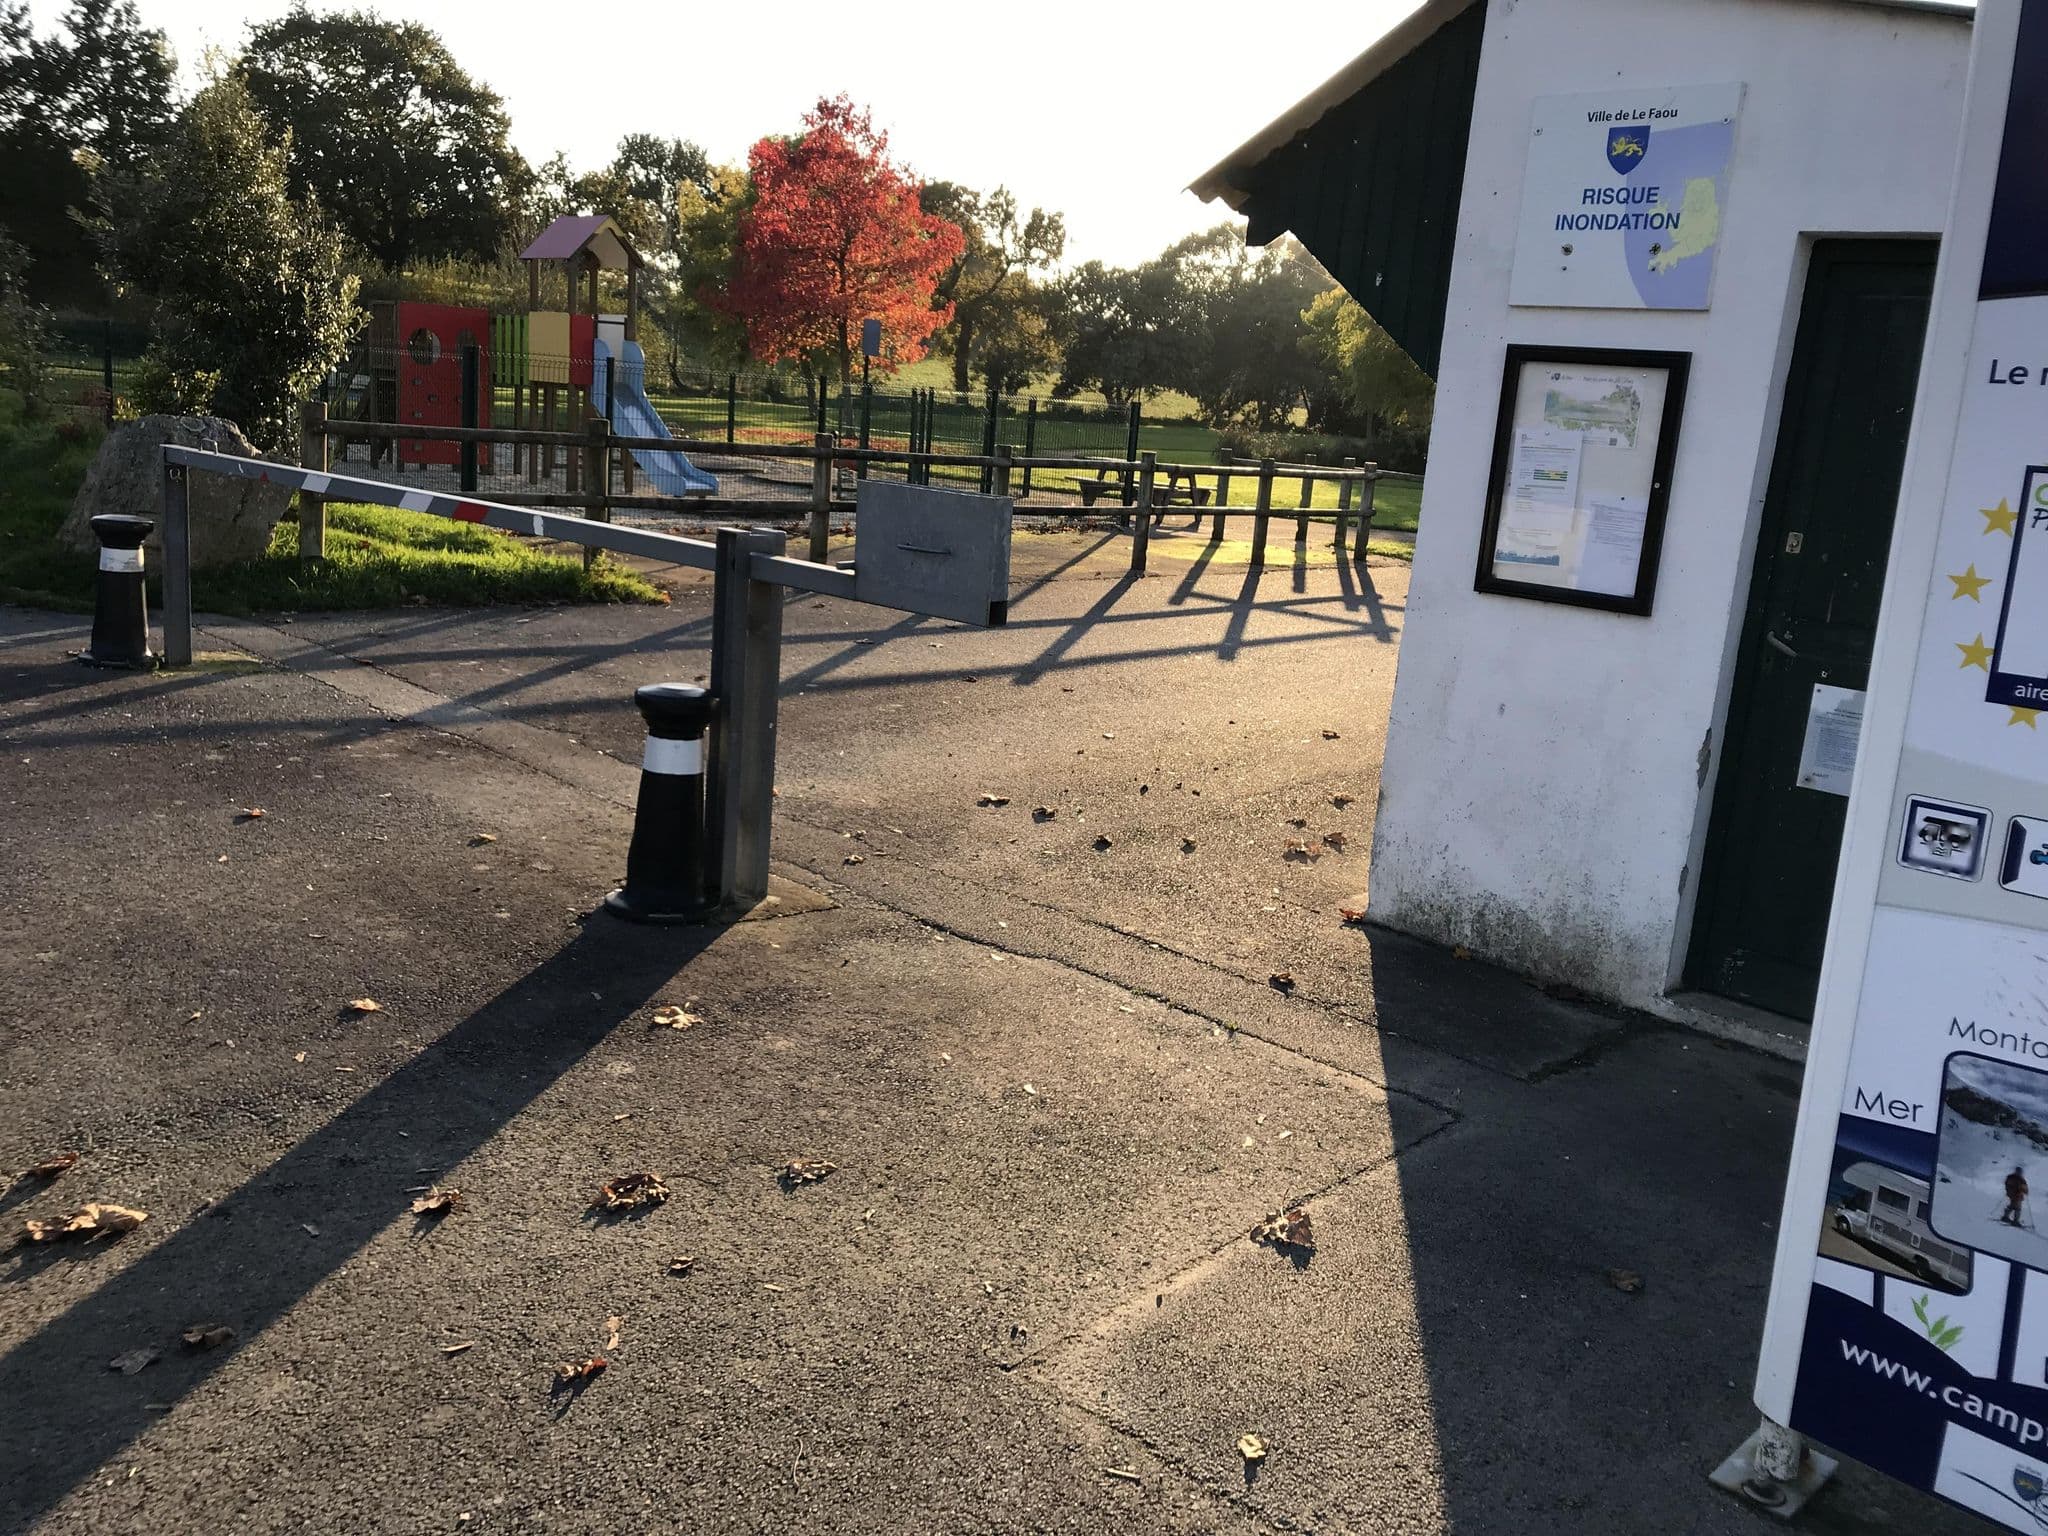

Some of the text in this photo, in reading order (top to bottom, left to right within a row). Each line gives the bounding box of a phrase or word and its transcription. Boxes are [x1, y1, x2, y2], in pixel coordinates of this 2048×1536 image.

[1587, 107, 1678, 122] Ville de Le Faou
[1582, 186, 1660, 205] RISQUE
[1555, 212, 1681, 231] INONDATION
[1989, 359, 2029, 385] Le
[1854, 1086, 1924, 1122] Mer
[1841, 1338, 2048, 1444] www.camp
